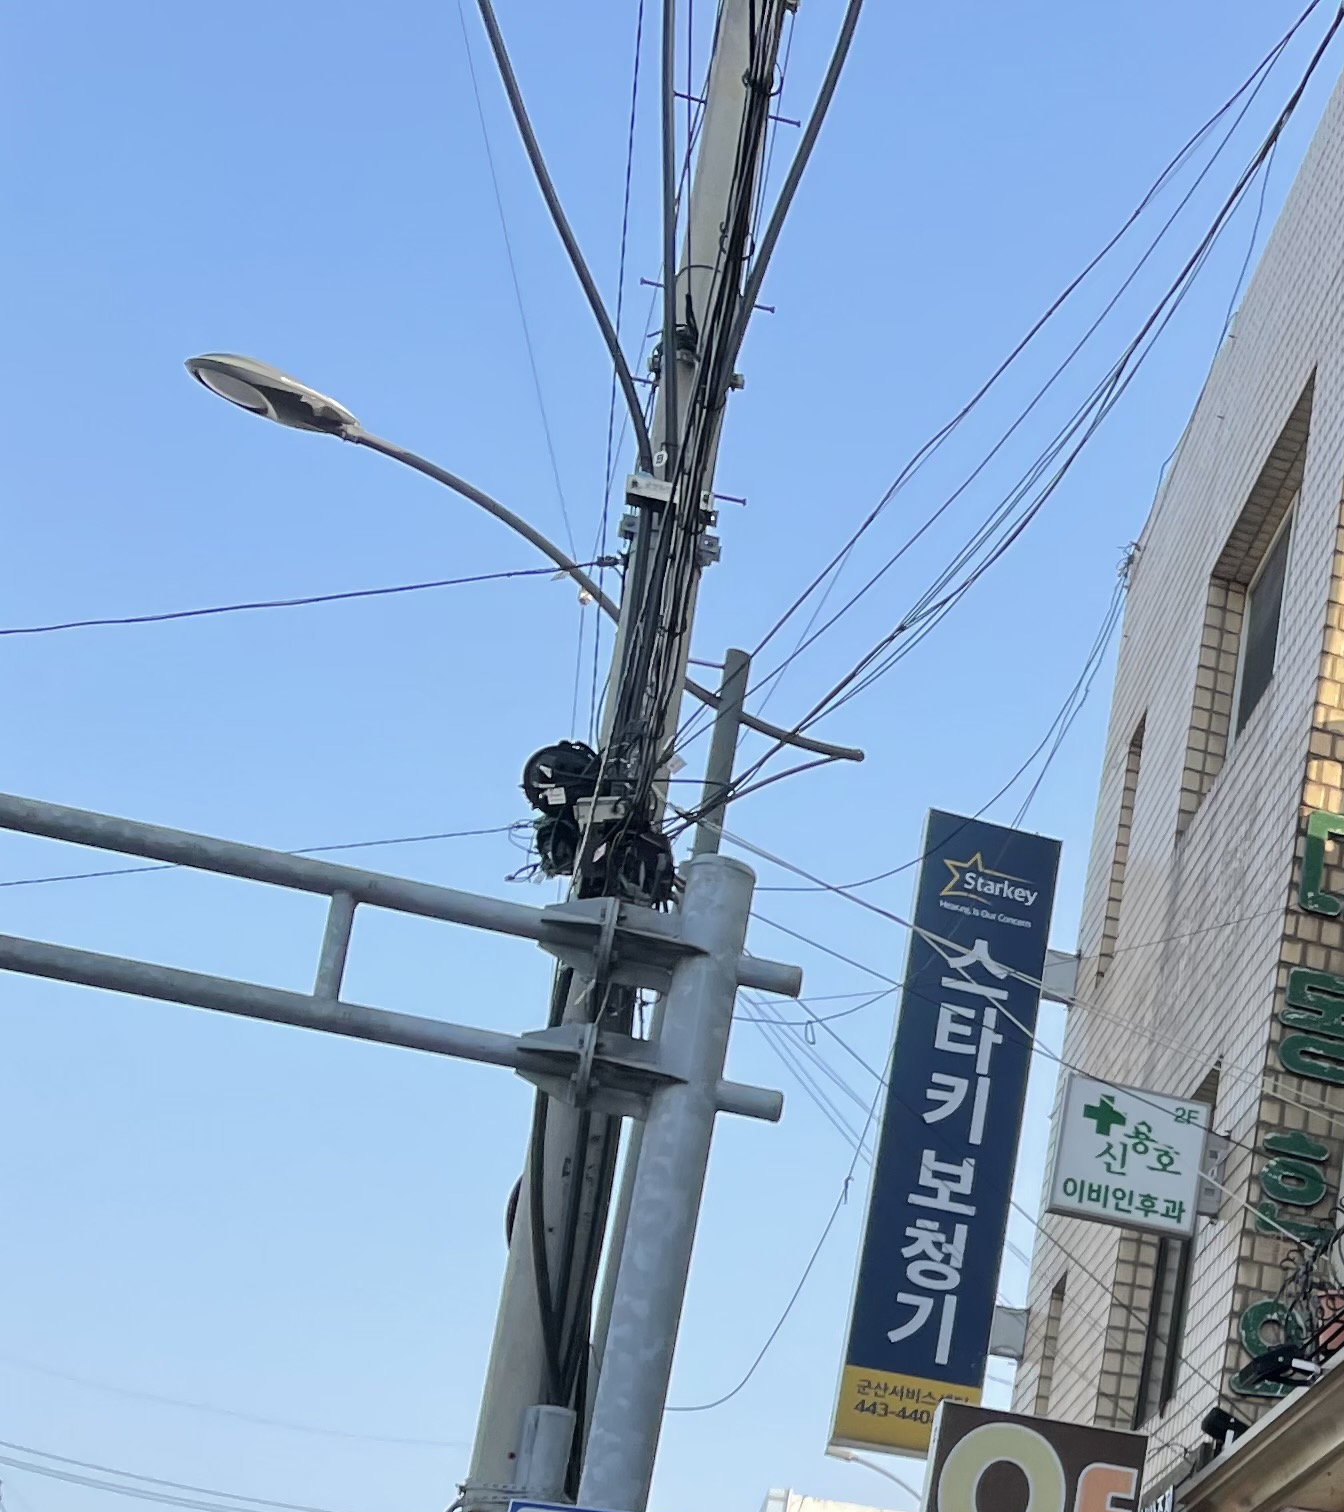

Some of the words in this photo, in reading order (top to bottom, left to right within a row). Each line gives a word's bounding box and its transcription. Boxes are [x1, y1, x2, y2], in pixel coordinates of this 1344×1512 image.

[963, 871, 1039, 906] Starkey
[922, 938, 1009, 1148] 스타키
[1174, 1106, 1200, 1125] 2F
[1062, 1177, 1186, 1225] 이비인후과
[887, 1149, 977, 1367] 보청기
[853, 1398, 935, 1425] 443-440
